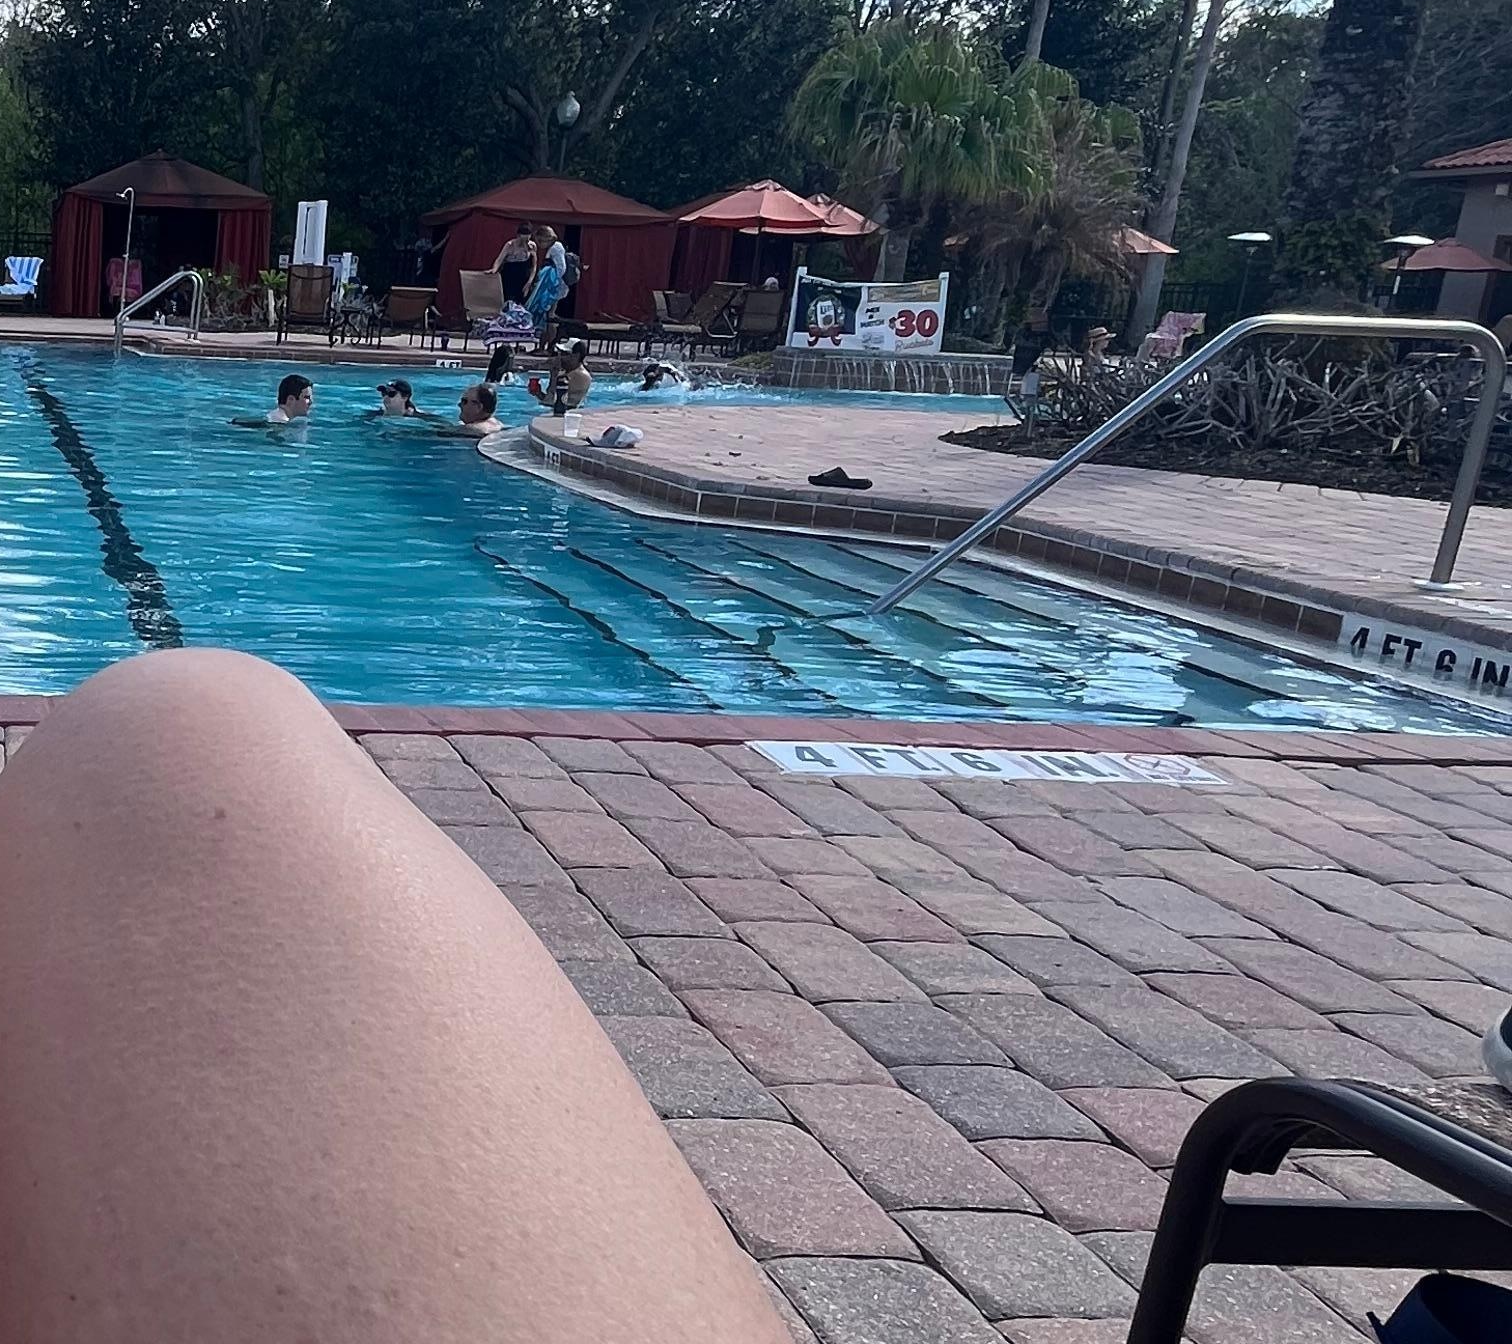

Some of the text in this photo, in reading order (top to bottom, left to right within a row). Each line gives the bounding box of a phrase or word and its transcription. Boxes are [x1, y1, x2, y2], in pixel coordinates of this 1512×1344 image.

[1381, 634, 1423, 665] FT
[1471, 657, 1510, 687] IN
[794, 746, 838, 768] 4
[950, 752, 1002, 772] 6
